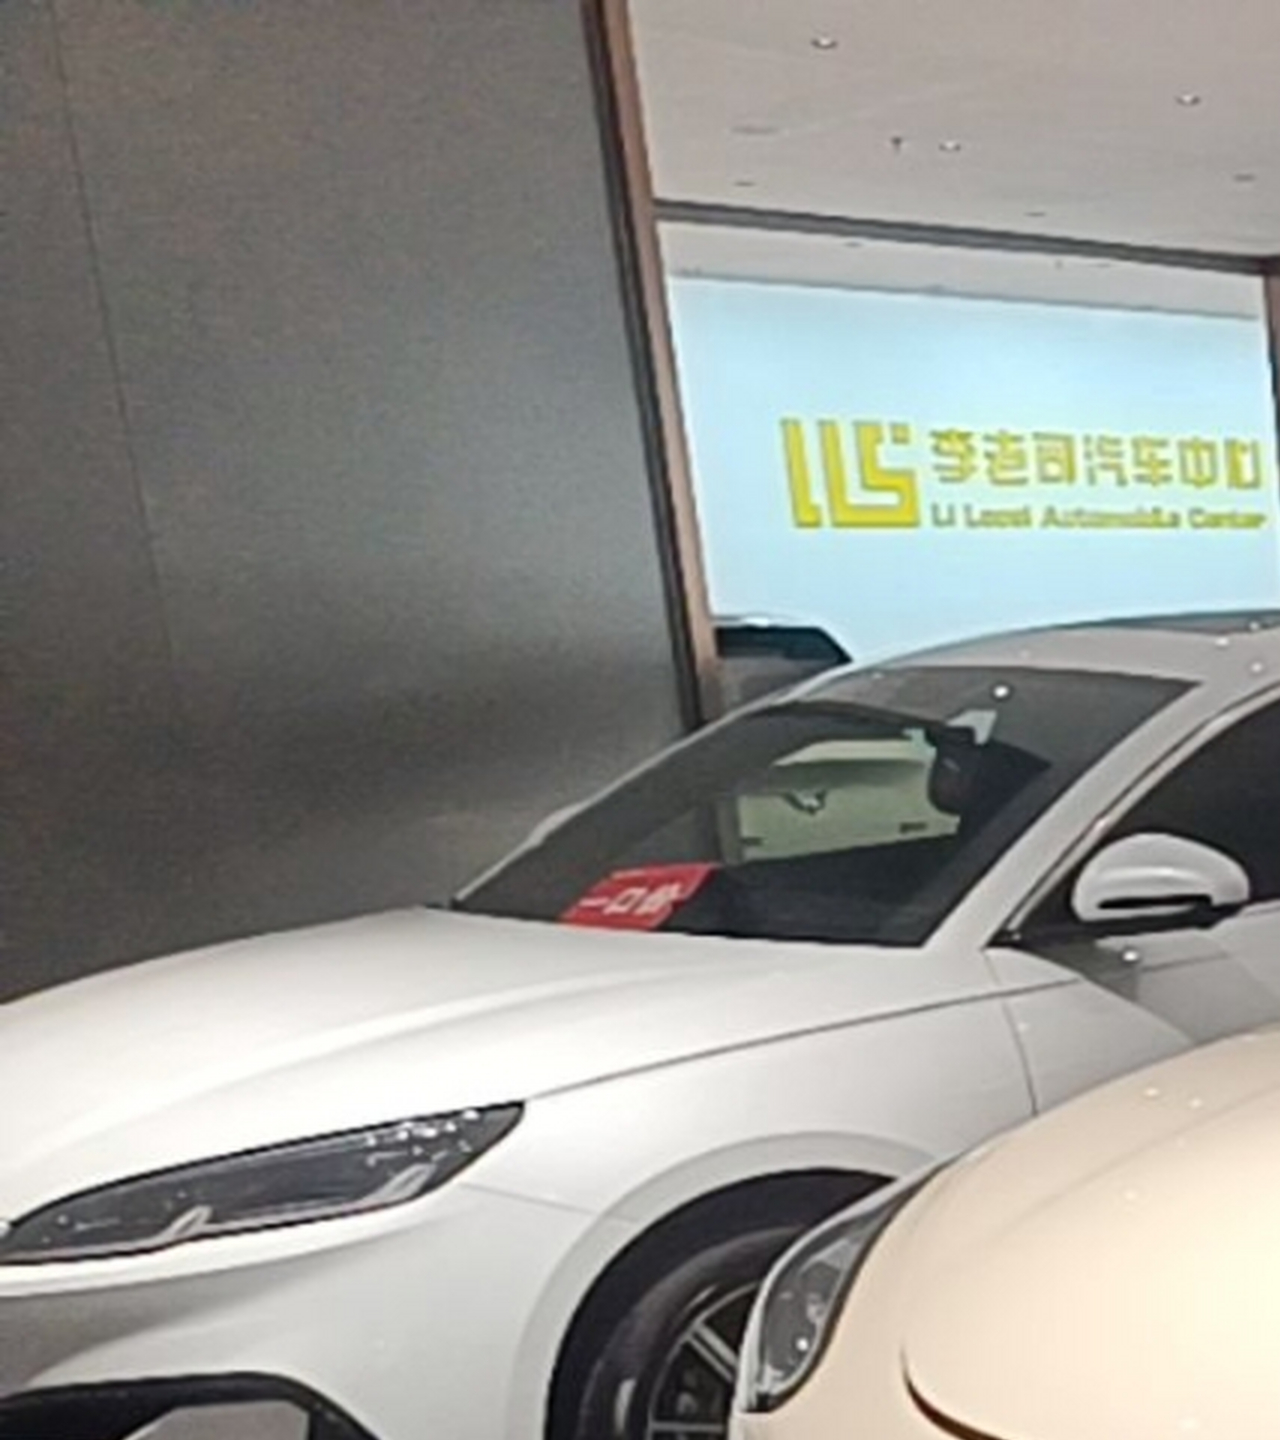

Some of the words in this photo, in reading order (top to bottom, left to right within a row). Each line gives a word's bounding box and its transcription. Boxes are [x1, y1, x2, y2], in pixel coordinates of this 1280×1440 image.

[929, 428, 1263, 490] 李老司汽车中心
